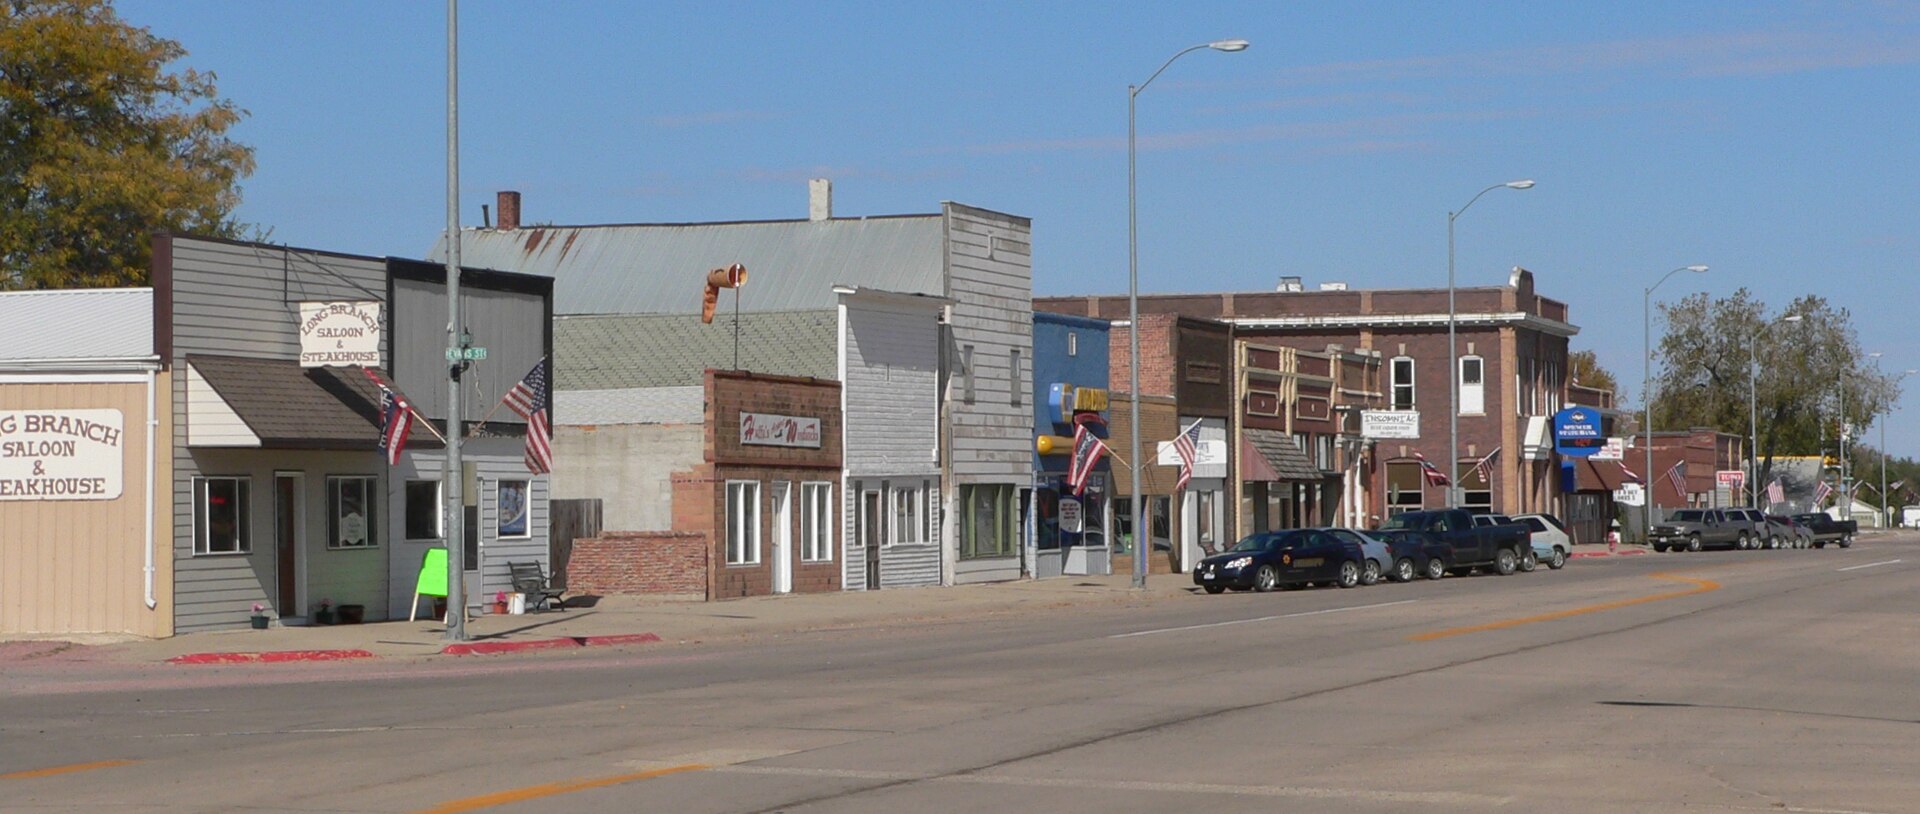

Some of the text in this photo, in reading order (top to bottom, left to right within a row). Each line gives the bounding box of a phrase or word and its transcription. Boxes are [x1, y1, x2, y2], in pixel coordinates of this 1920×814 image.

[301, 305, 379, 335] LONG BRANCH
[317, 327, 364, 338] SALOON
[336, 339, 344, 349] &
[302, 352, 377, 362] STEAKHOUSE
[24, 414, 121, 447] BRANCH
[2, 441, 76, 457] SALOON
[33, 460, 45, 476] &
